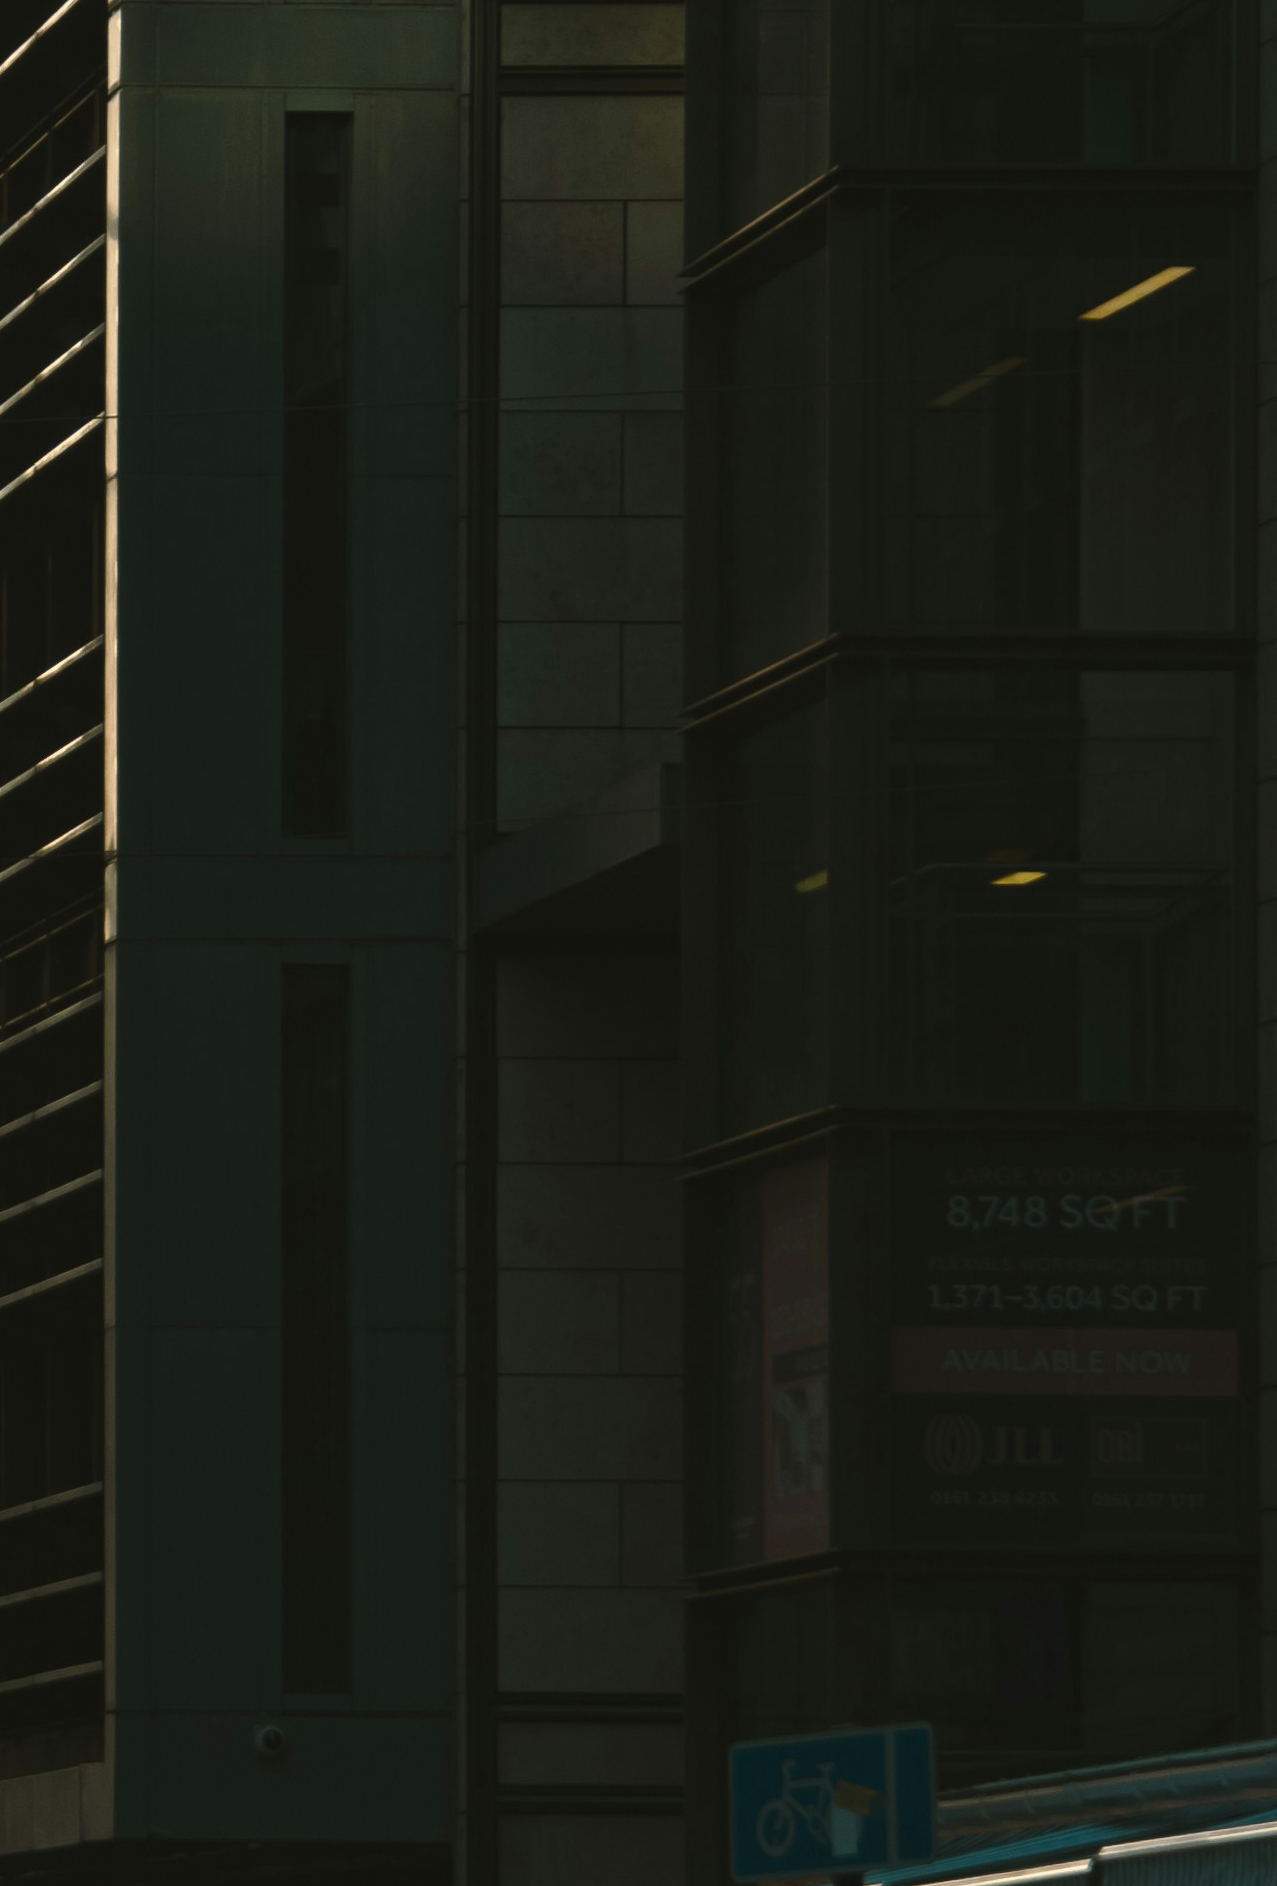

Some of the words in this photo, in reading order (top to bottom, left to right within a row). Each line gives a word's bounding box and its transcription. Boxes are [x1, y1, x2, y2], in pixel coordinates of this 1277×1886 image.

[946, 1167, 1027, 1186] LARGE
[1033, 1167, 1185, 1186] WORKSPACE
[947, 1195, 1049, 1232] 8,748
[1060, 1194, 1121, 1230] SQ
[1133, 1195, 1186, 1229] FT
[1111, 1285, 1159, 1312] SQ
[1167, 1286, 1208, 1312] FT
[942, 1347, 1106, 1374] AVAILABLE
[1115, 1350, 1192, 1375] NOW
[986, 1426, 1064, 1464] JLL
